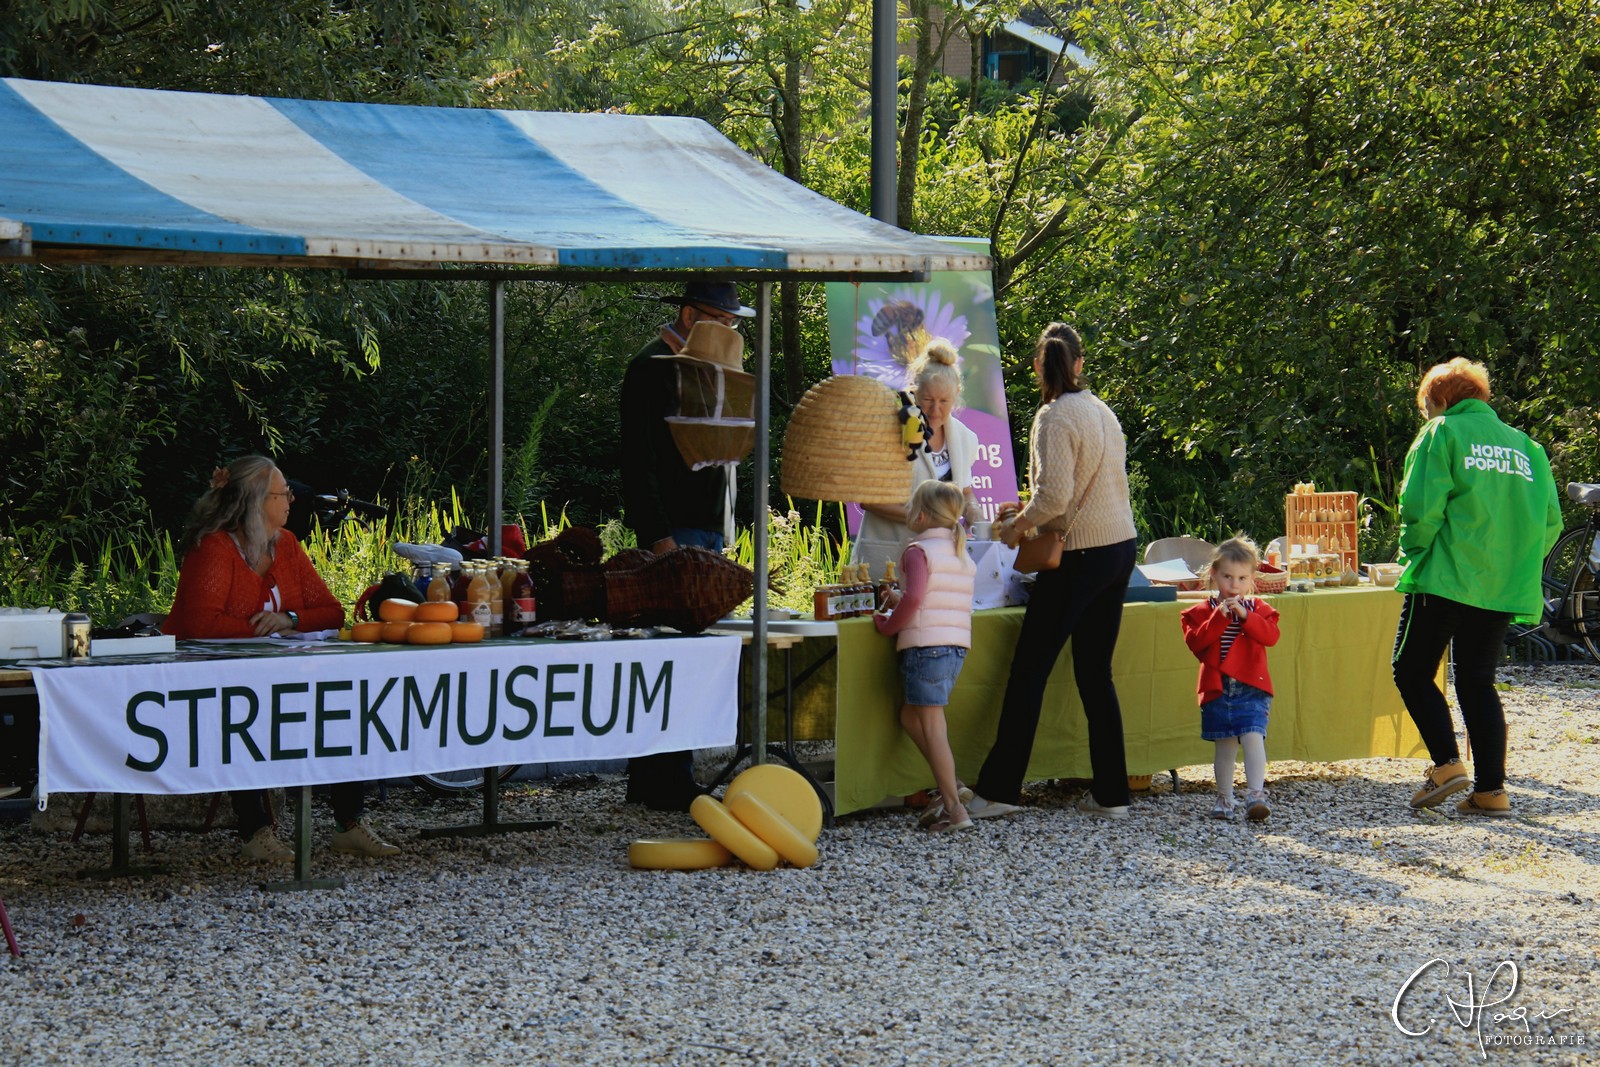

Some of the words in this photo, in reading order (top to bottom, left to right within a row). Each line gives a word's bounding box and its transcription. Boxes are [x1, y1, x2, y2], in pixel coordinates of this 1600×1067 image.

[975, 443, 1003, 468] ng
[1471, 443, 1513, 460] HORT
[970, 475, 993, 489] en
[126, 660, 674, 772] STREEKMUSEUM
